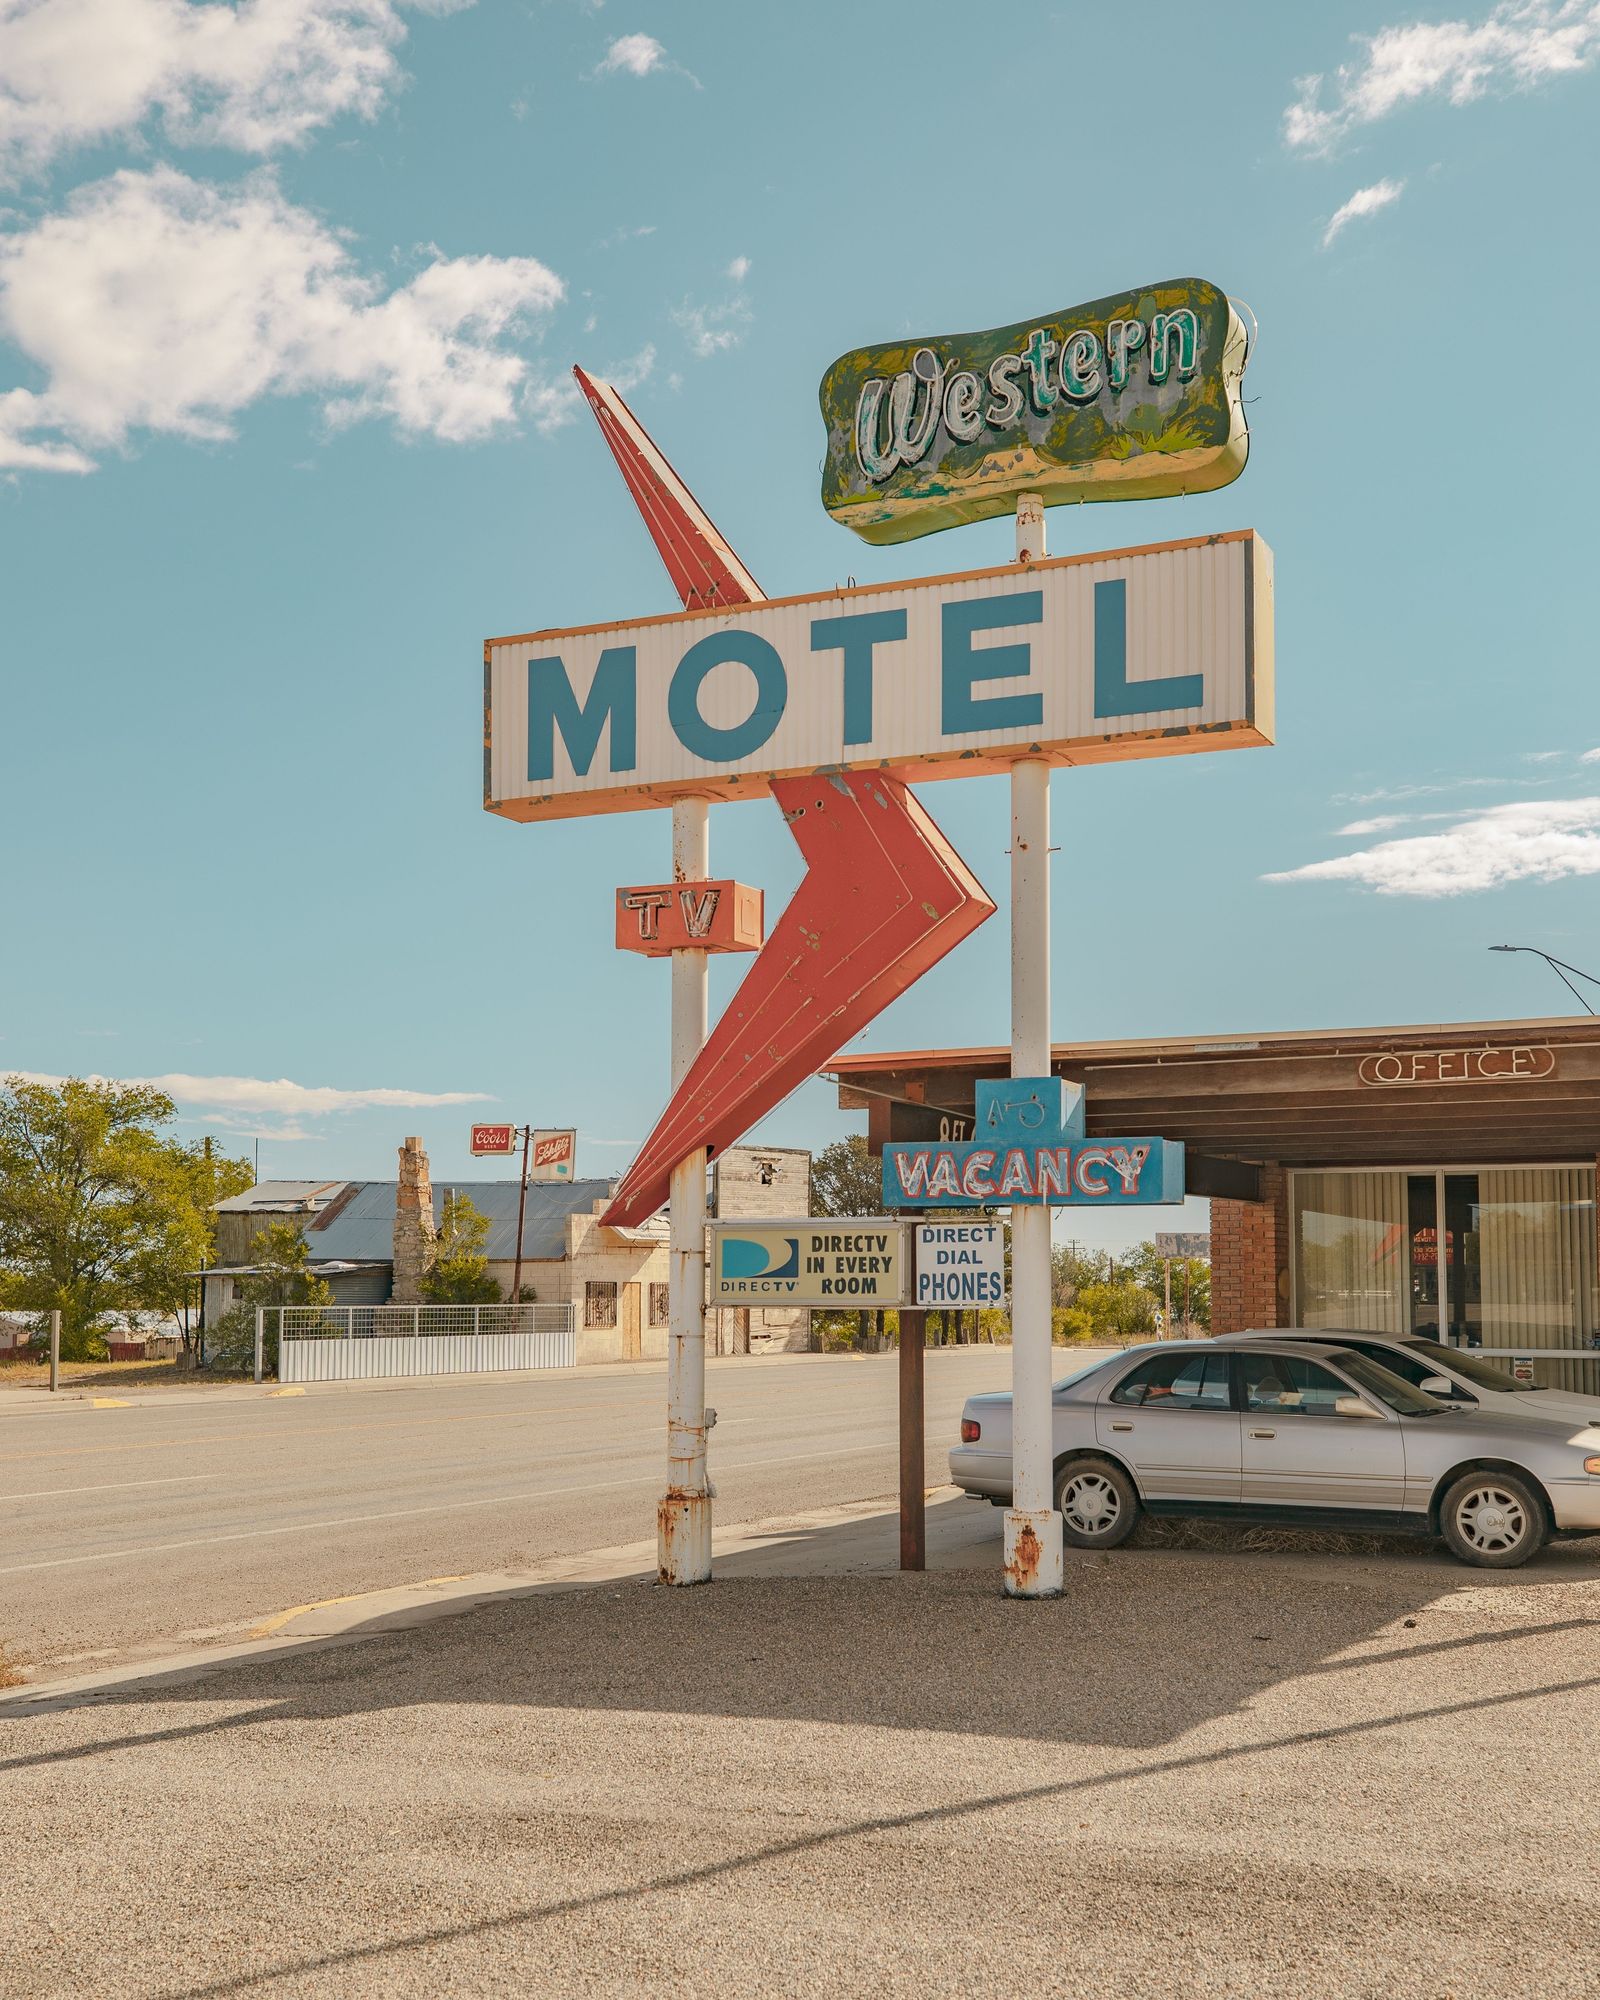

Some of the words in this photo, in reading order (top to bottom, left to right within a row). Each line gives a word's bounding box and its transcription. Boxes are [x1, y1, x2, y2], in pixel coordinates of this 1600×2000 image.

[854, 307, 1201, 482] Western
[527, 578, 1204, 782] MOTEL
[625, 889, 722, 941] TV
[1374, 1048, 1534, 1082] OFFICE
[475, 1130, 507, 1144] Coors
[893, 1145, 1151, 1198] VACANCY
[811, 1235, 888, 1253] DIRECTV
[922, 1227, 997, 1243] DIRECT
[806, 1256, 825, 1273] IN
[835, 1256, 893, 1274] EVERY
[936, 1250, 983, 1265] DIAL
[821, 1276, 878, 1295] ROOM
[919, 1271, 1001, 1301] PHONES
